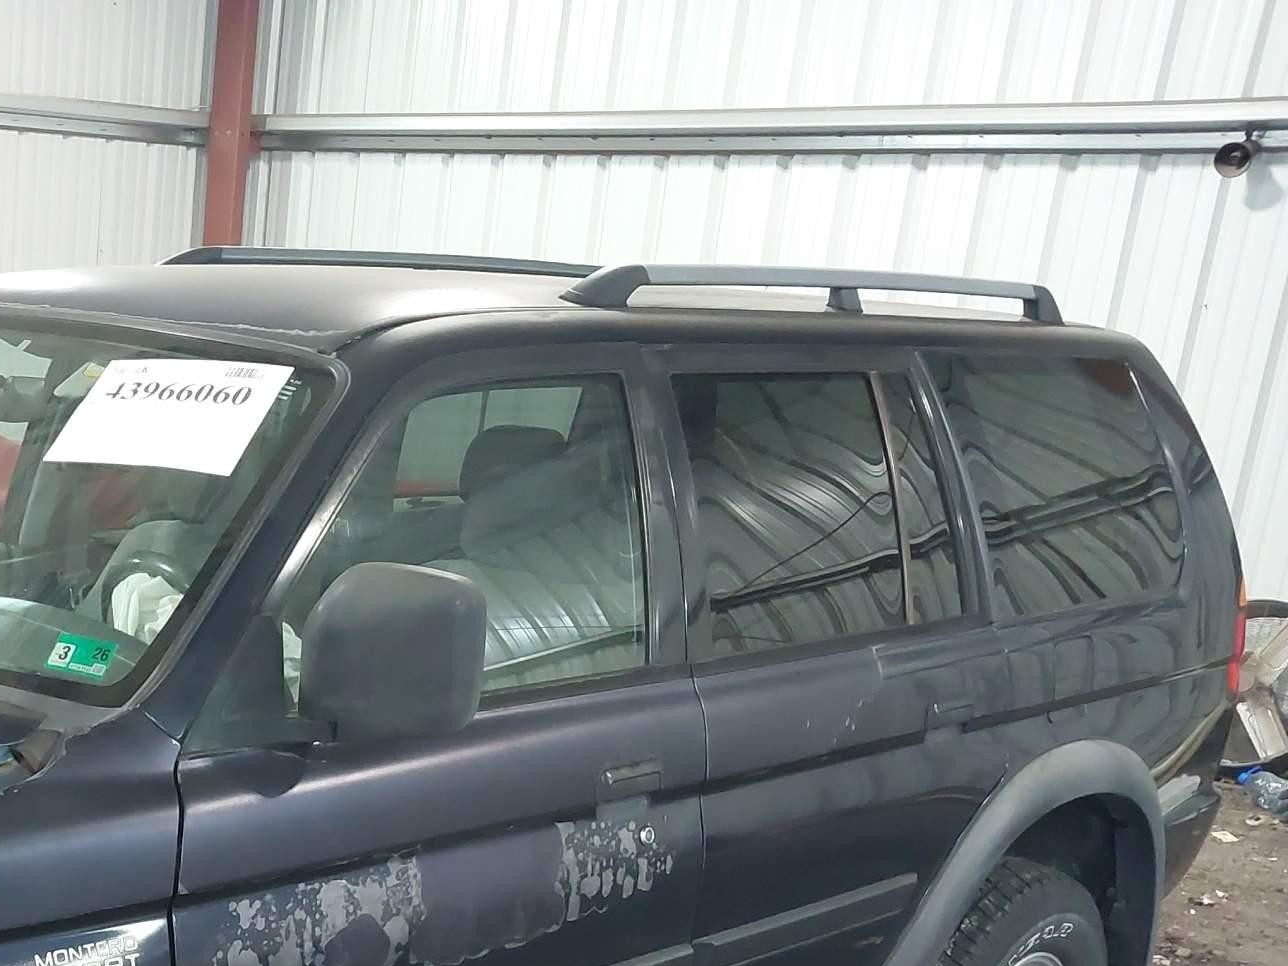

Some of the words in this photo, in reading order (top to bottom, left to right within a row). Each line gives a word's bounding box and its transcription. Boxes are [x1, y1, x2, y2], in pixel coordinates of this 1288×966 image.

[106, 382, 252, 406] 43966060
[58, 645, 72, 661] 3
[92, 647, 111, 662] 26
